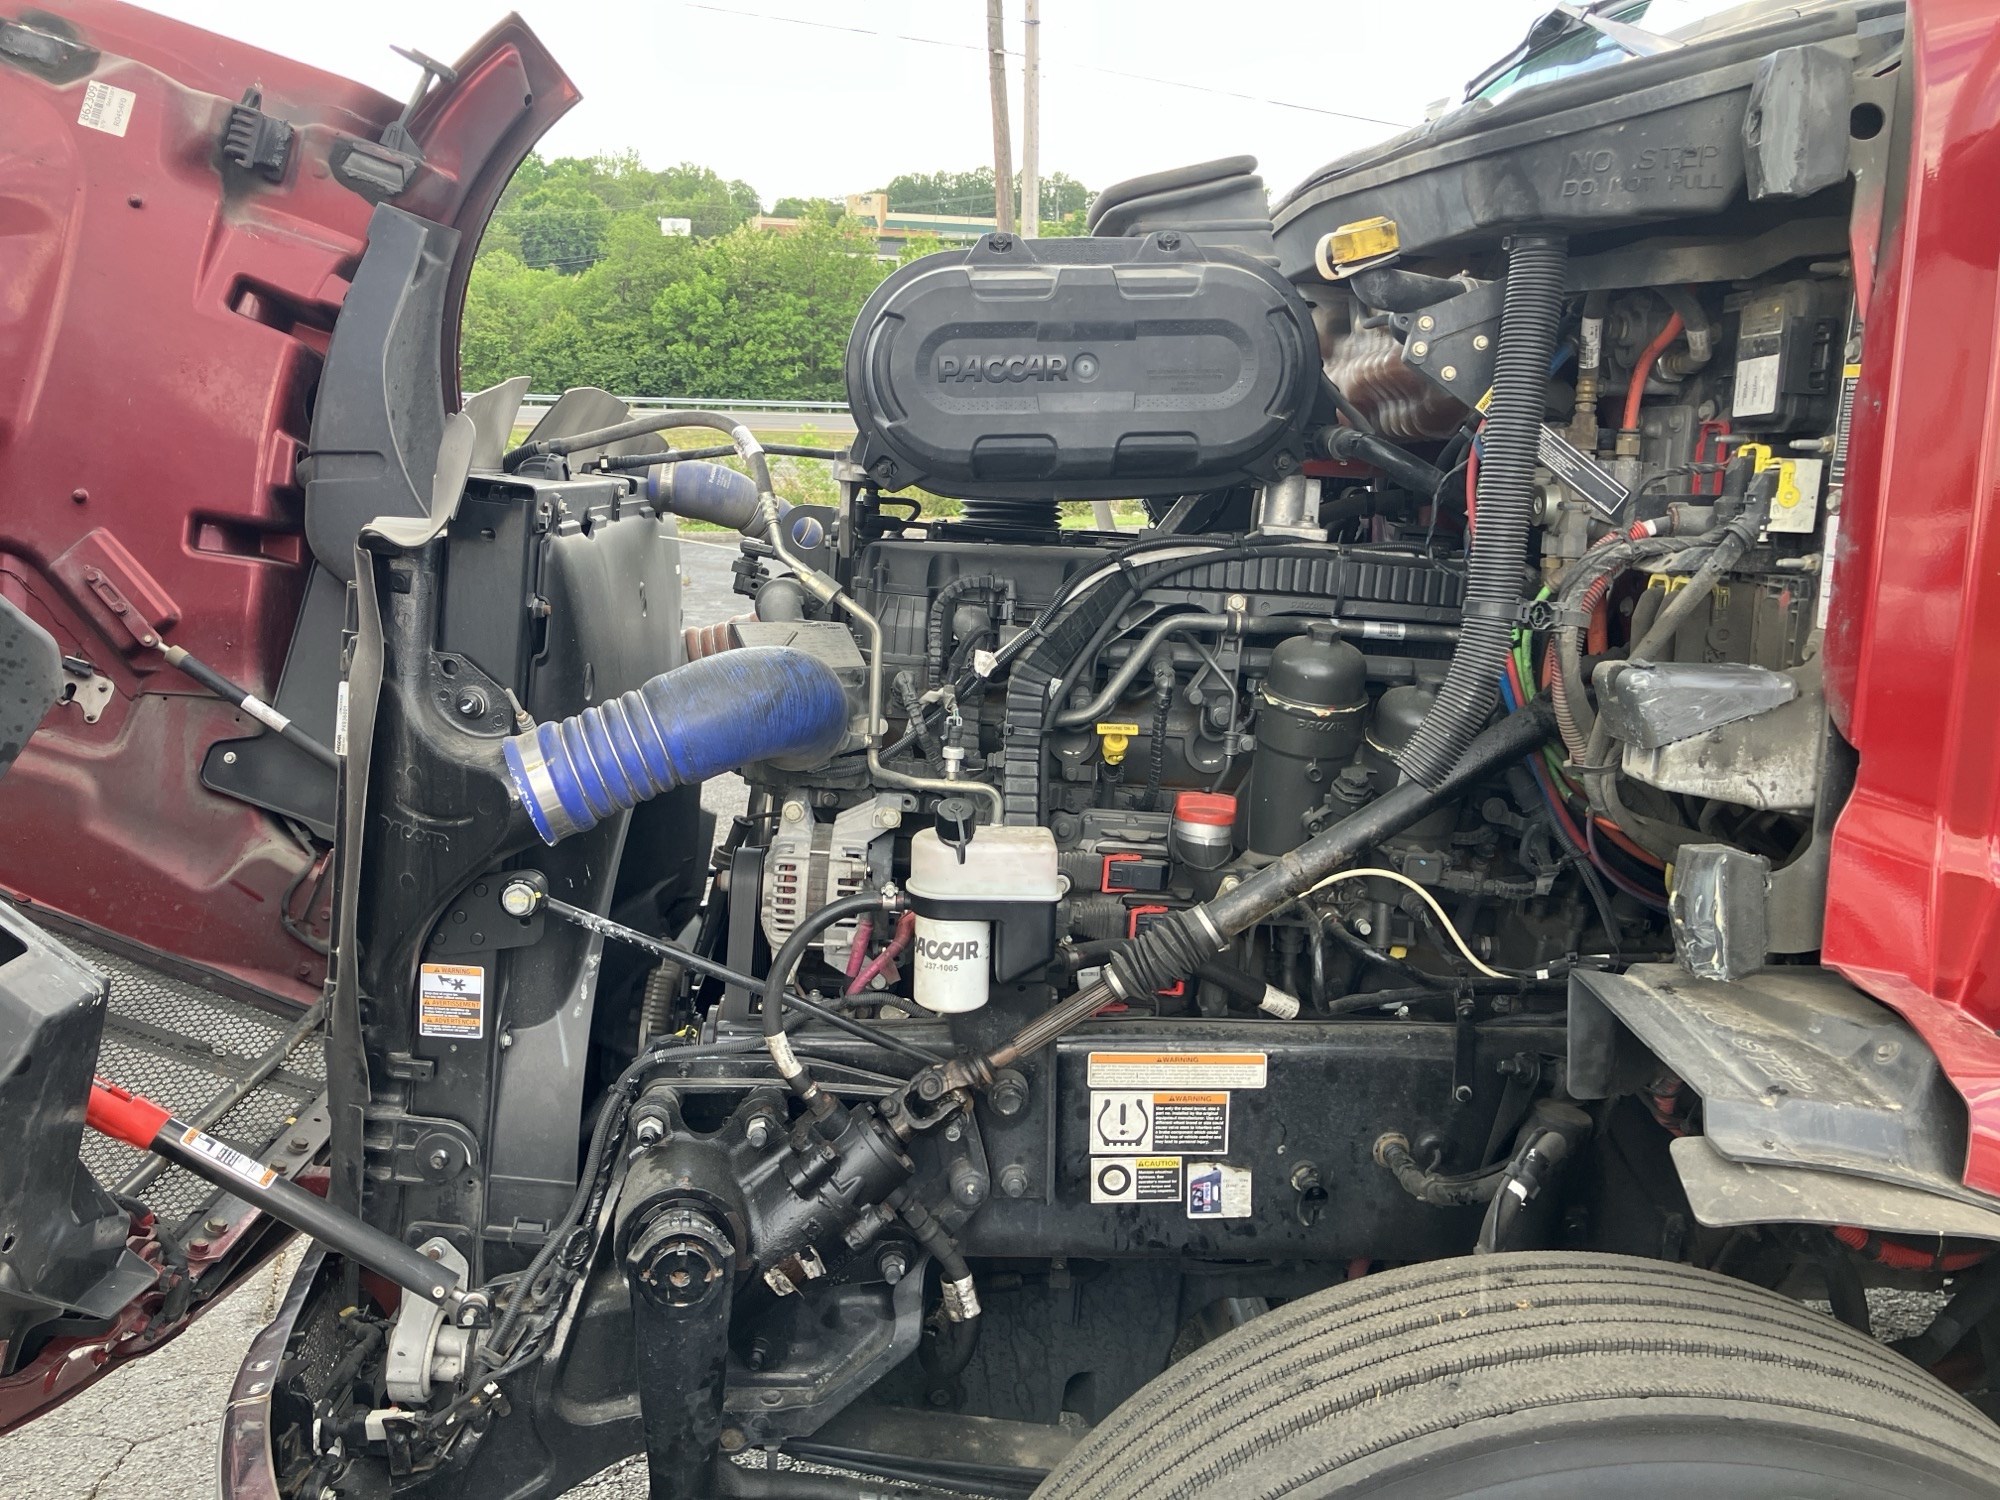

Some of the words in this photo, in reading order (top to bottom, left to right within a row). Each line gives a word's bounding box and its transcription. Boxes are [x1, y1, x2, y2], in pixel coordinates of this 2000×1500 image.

[80, 85, 97, 120] 862309
[1638, 145, 1719, 170] STEP
[1562, 179, 1596, 197] DO
[1668, 175, 1723, 191] PULL
[938, 354, 1069, 384] PACCAR
[441, 967, 471, 975] WARNING
[924, 962, 959, 972] J37-1005
[435, 1017, 476, 1025] ADVERTENCIA
